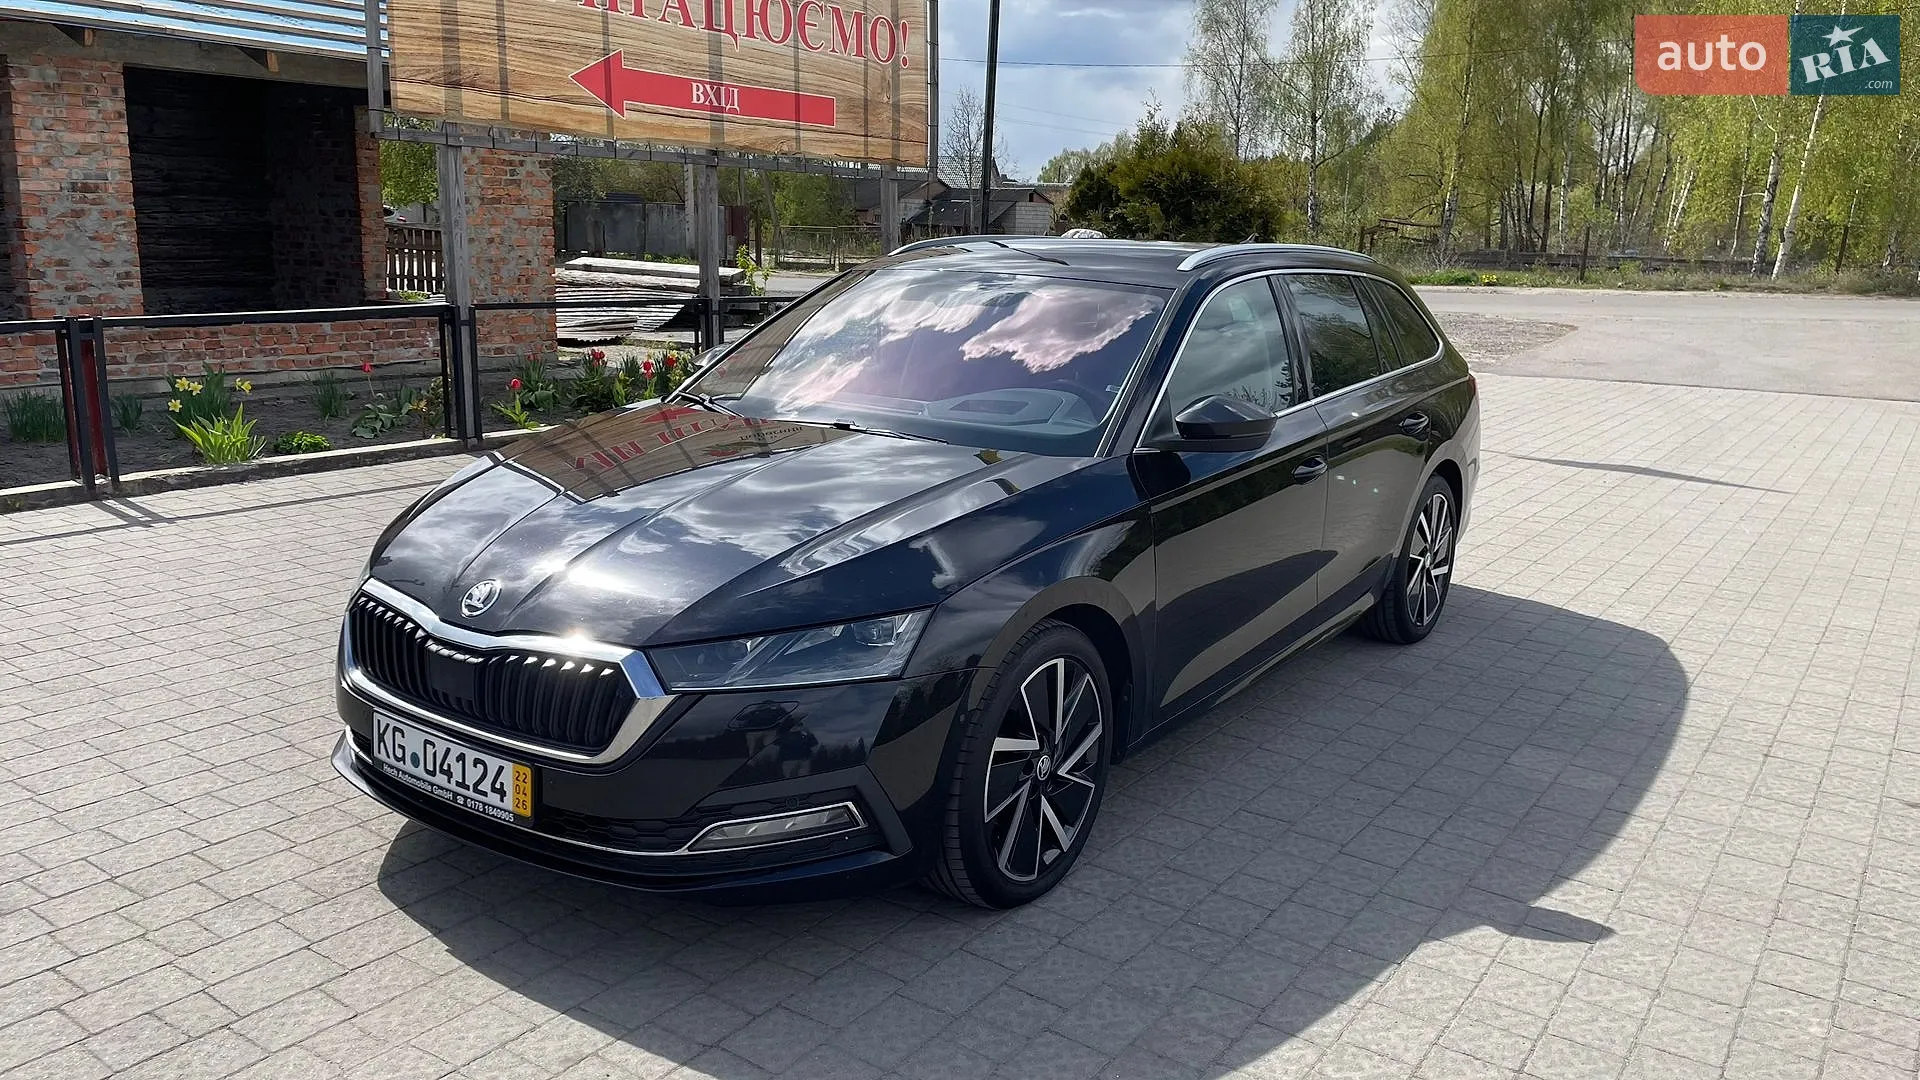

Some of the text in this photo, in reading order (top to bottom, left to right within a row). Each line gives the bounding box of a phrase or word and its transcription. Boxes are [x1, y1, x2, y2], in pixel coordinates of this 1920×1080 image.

[577, 0, 909, 68] АЦЮЄМО!
[690, 81, 740, 114] ВХІД
[376, 718, 507, 803] KG 04124
[398, 771, 432, 791] Automobile
[432, 785, 453, 801] GmbH
[515, 770, 528, 784] 22
[515, 784, 528, 797] 04
[515, 797, 528, 810] 26
